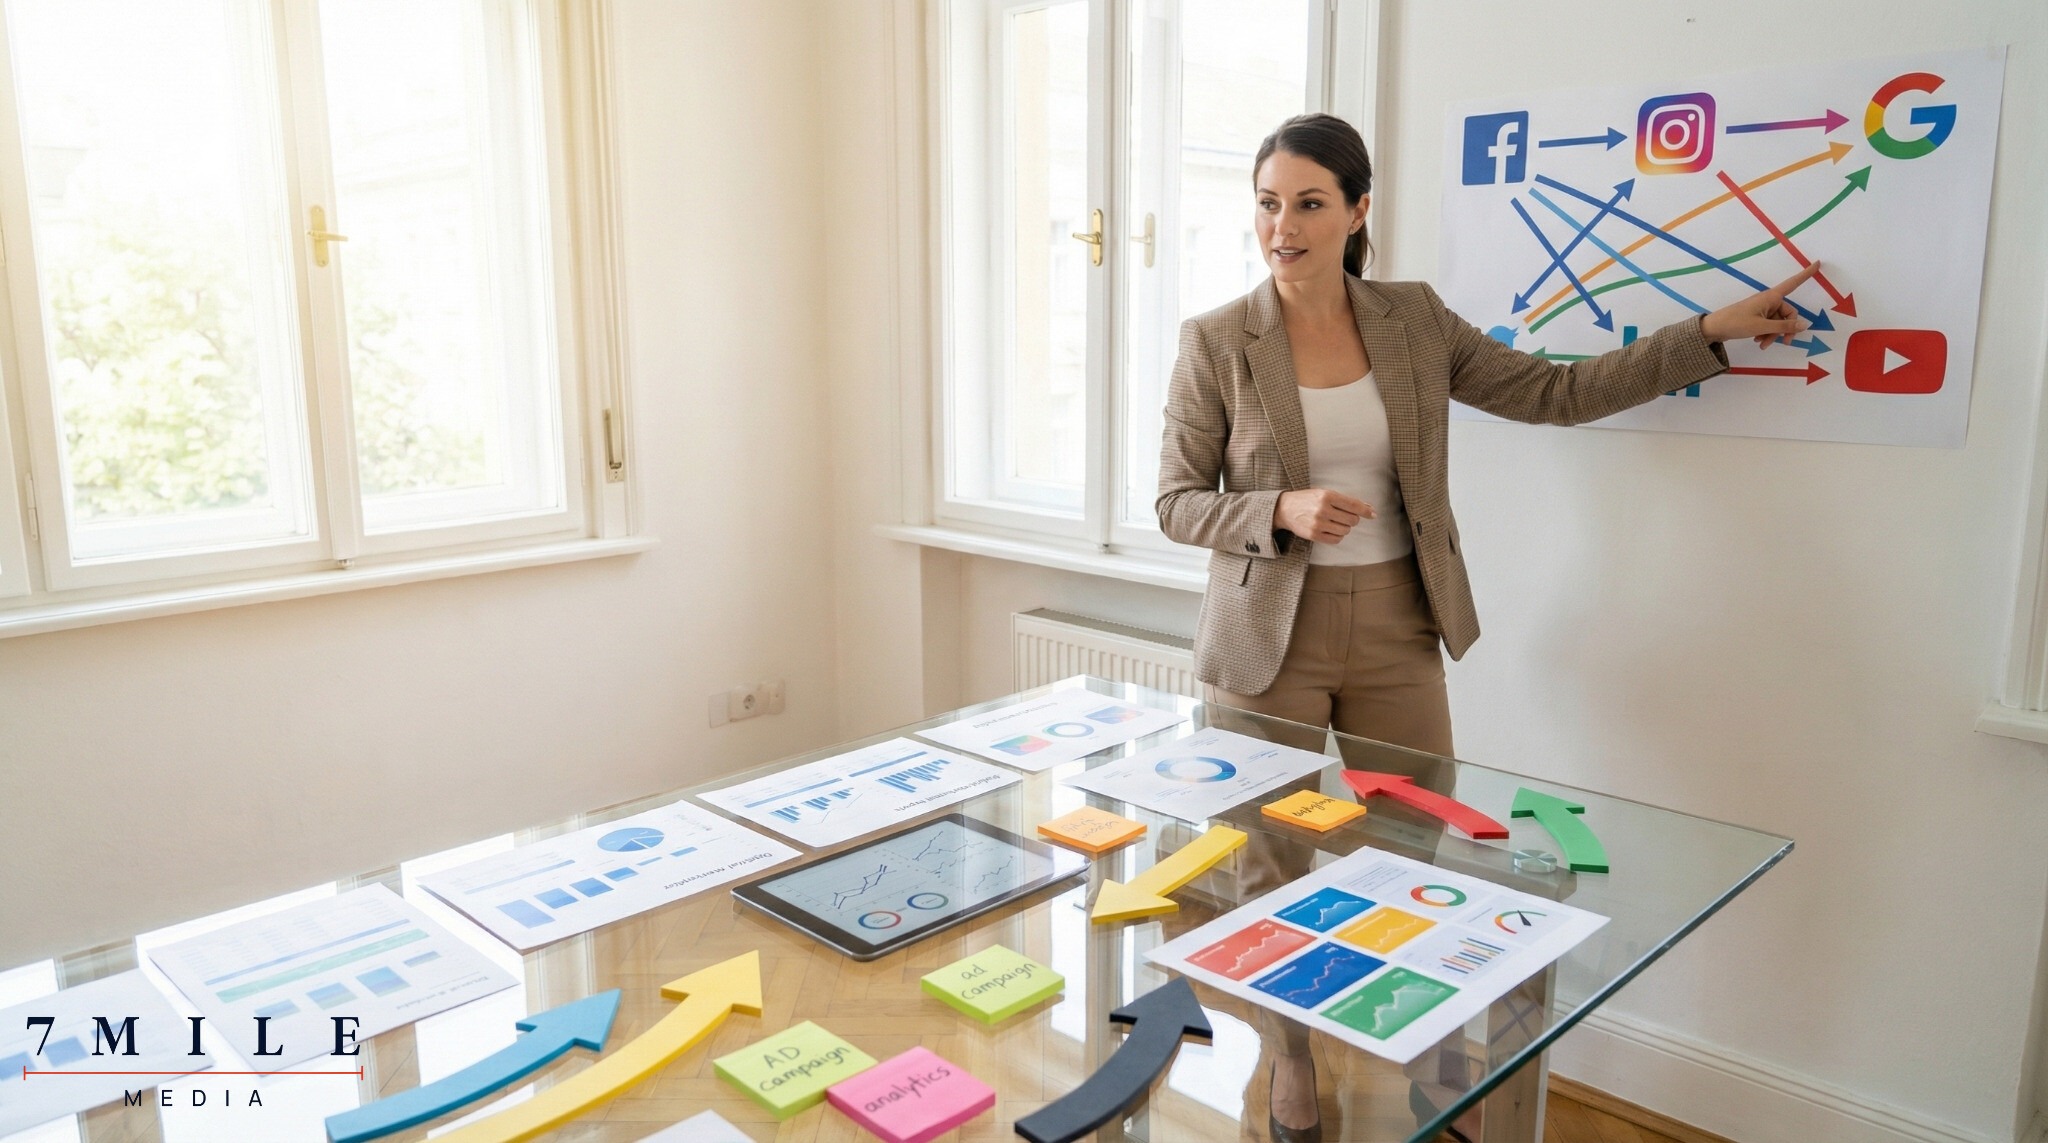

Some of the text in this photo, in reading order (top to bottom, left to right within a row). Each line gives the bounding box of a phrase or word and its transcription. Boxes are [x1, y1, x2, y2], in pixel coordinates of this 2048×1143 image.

[1863, 71, 1958, 160] G
[960, 964, 988, 980] ad
[961, 962, 1037, 1001] campaign
[759, 1046, 850, 1093] campaign
[763, 1046, 801, 1069] AD
[864, 1064, 952, 1113] analytics
